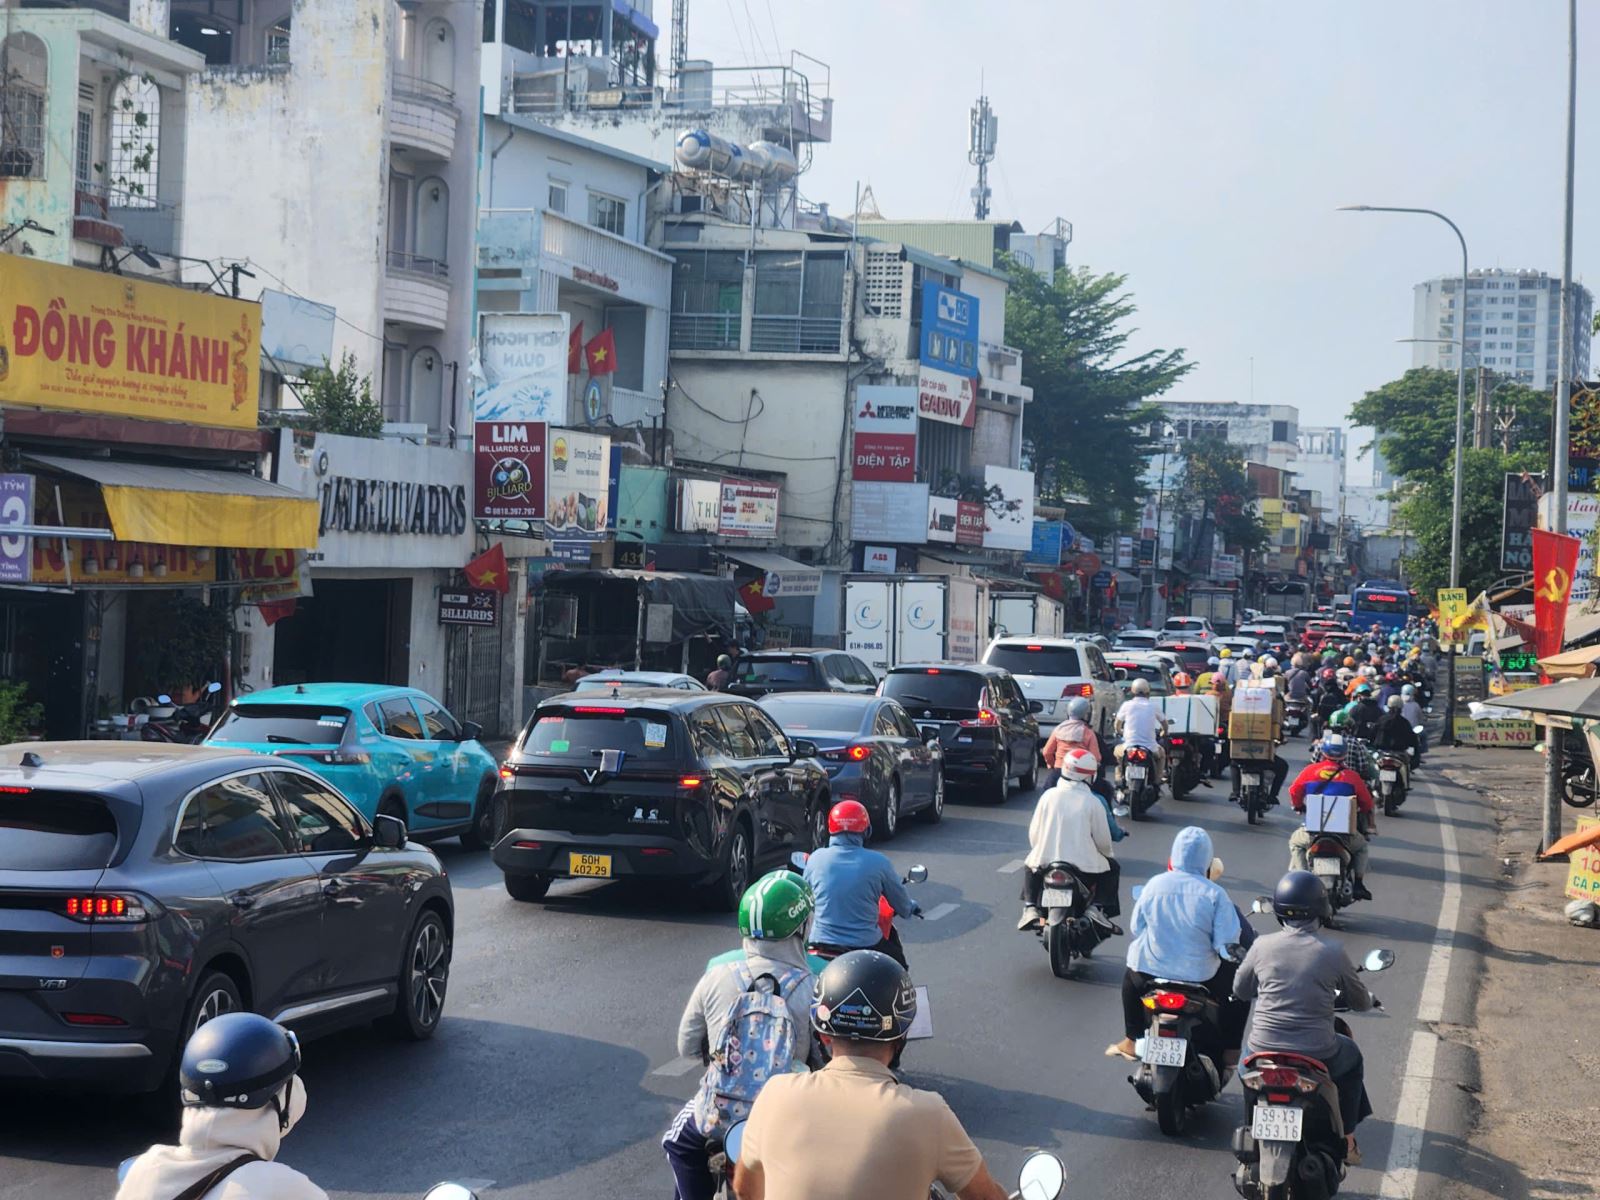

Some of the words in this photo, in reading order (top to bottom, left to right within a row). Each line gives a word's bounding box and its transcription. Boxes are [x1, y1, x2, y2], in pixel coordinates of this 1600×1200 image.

[13, 297, 116, 368] ĐỒNG
[126, 321, 229, 385] KHÁNH
[492, 425, 528, 443] LIM
[479, 445, 519, 453] BILLIARDS
[520, 445, 541, 453] CLUB
[857, 452, 885, 469] ĐIỆN
[487, 482, 533, 498] BILLIARD
[441, 608, 494, 621] BILLIARDS
[581, 854, 600, 864] 60H
[573, 865, 607, 876] 402.29
